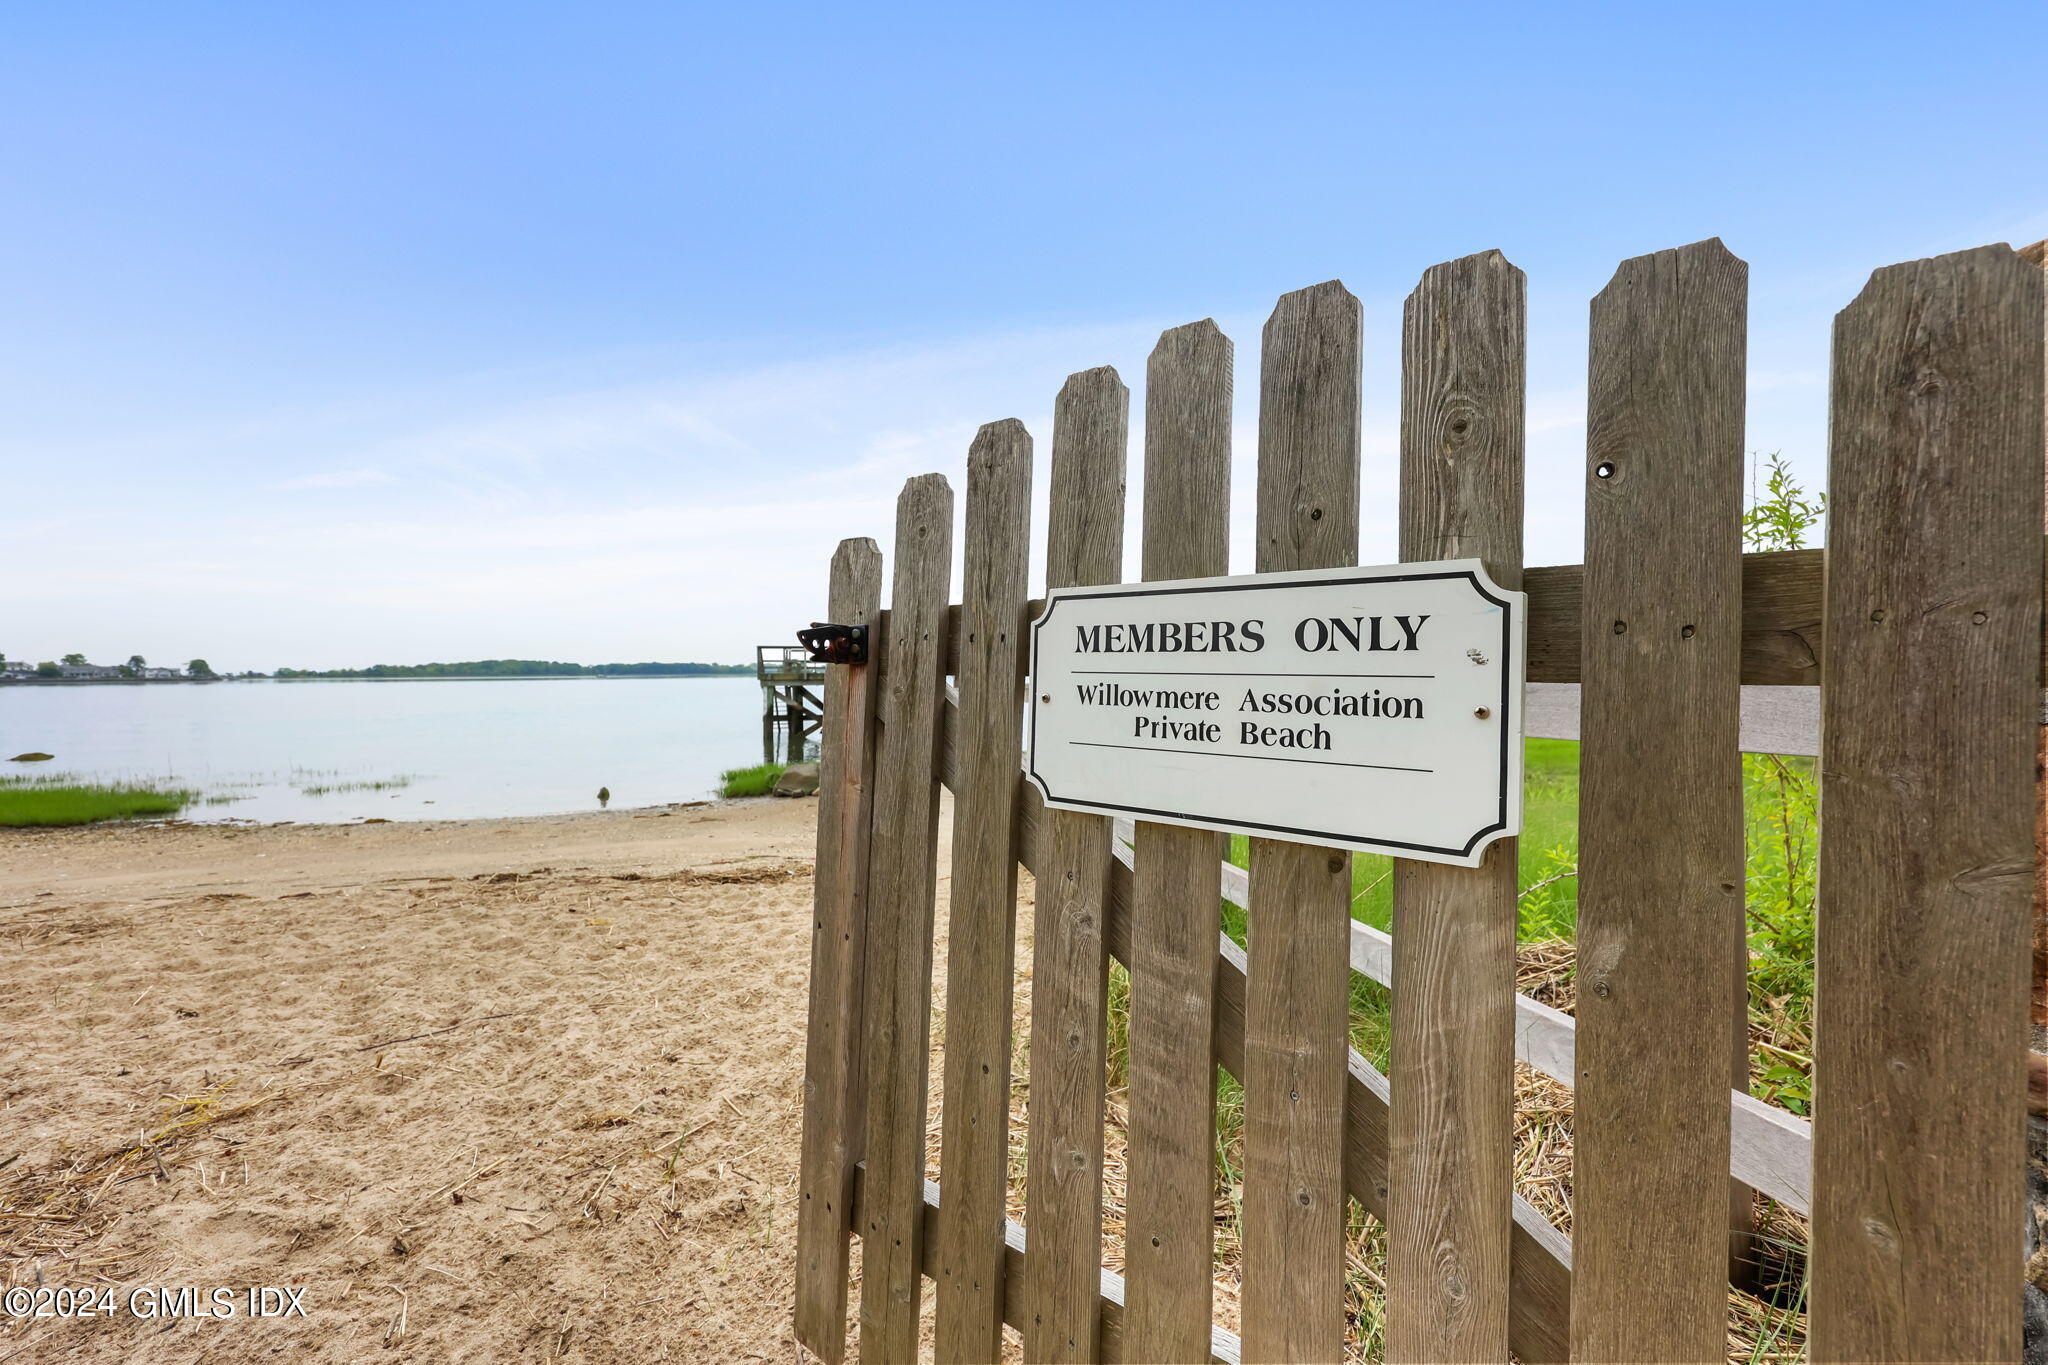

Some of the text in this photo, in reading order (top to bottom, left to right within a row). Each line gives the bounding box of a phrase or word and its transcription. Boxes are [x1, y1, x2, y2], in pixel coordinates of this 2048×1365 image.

[1075, 615, 1431, 653] MEMBERS ONLY
[1077, 683, 1424, 719] Willowmere Association
[1134, 716, 1332, 750] Private Beach
